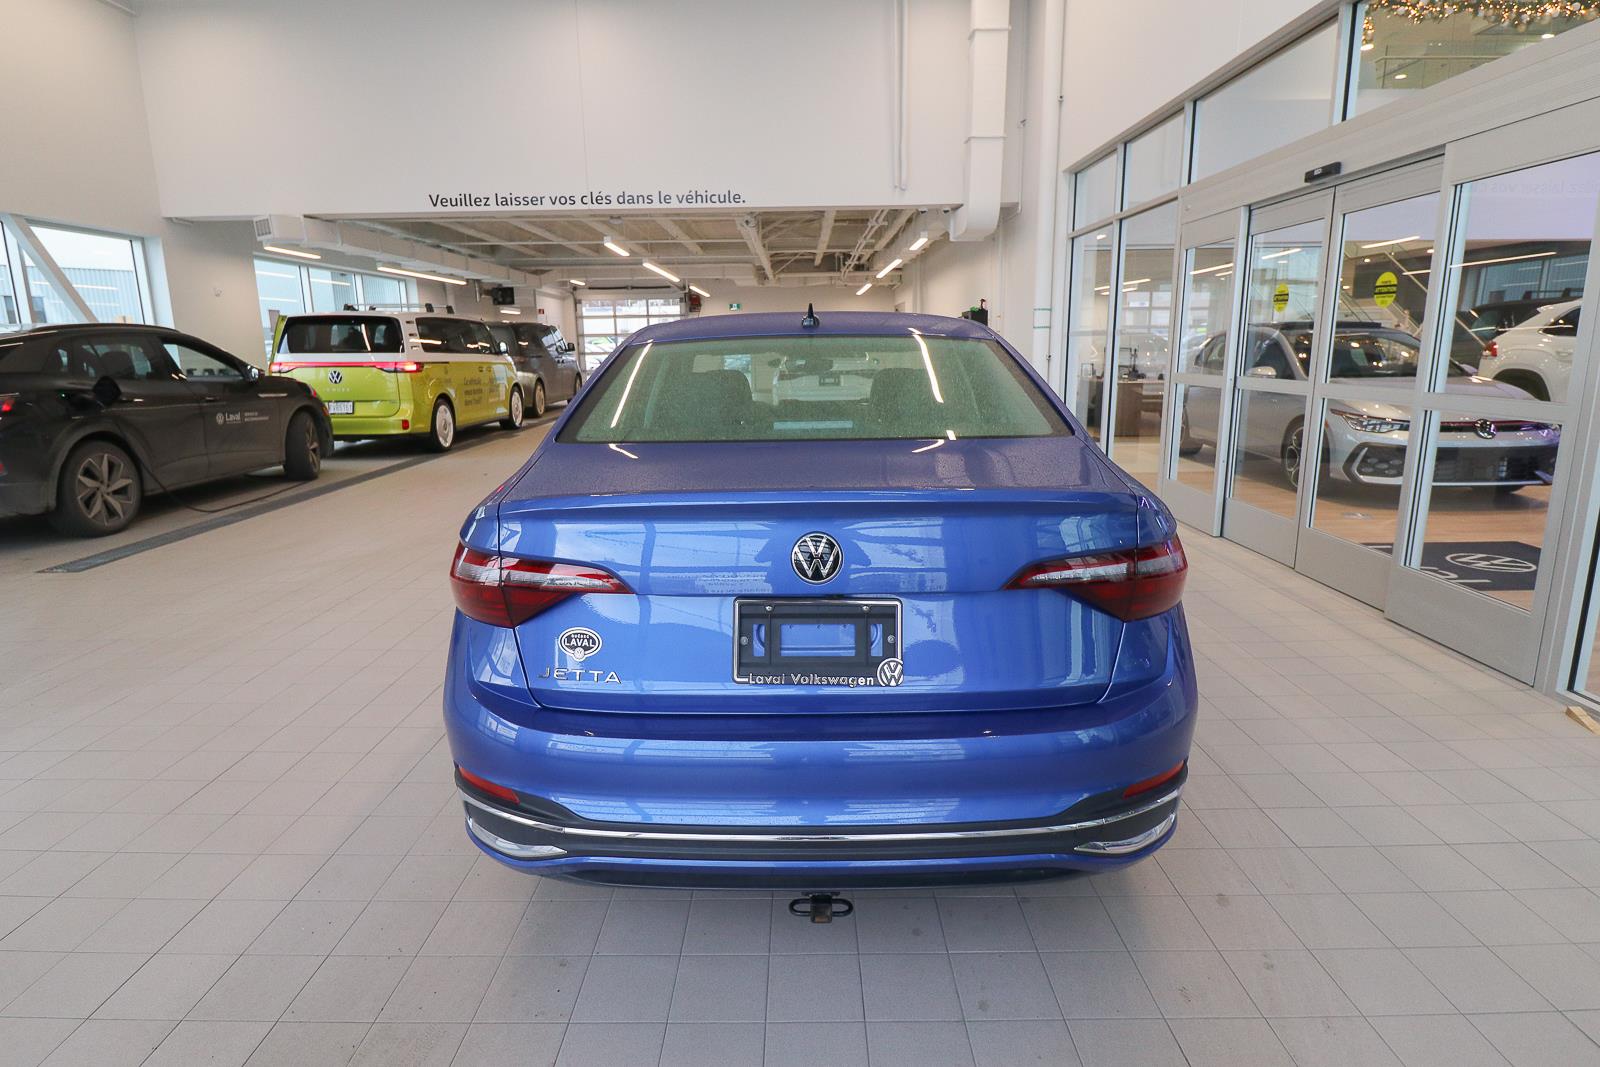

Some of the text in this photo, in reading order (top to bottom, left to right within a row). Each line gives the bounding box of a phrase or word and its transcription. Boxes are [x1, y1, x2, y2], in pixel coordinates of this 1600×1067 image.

[428, 189, 746, 207] Veuillez laisser vos clés dans le véhicule.
[792, 533, 842, 583] VW
[564, 638, 595, 648] LAVAL
[537, 665, 622, 684] JETTA
[749, 673, 875, 688] Laval Volkswagen
